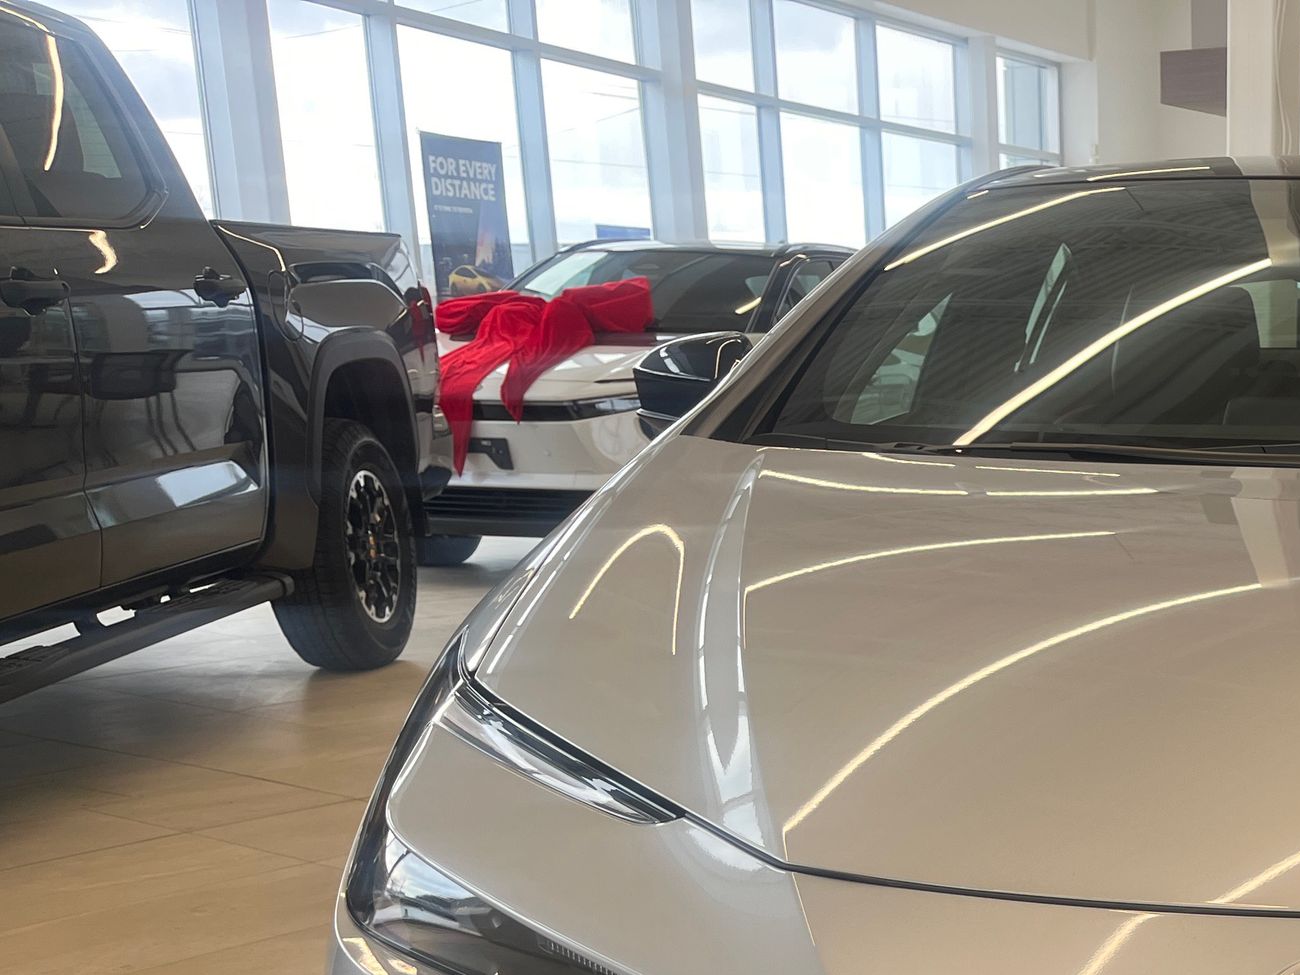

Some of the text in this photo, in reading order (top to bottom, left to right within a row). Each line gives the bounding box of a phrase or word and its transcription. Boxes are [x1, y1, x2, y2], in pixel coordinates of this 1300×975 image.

[428, 155, 496, 181] FOR EVERY
[431, 176, 496, 201] DISTANCE
